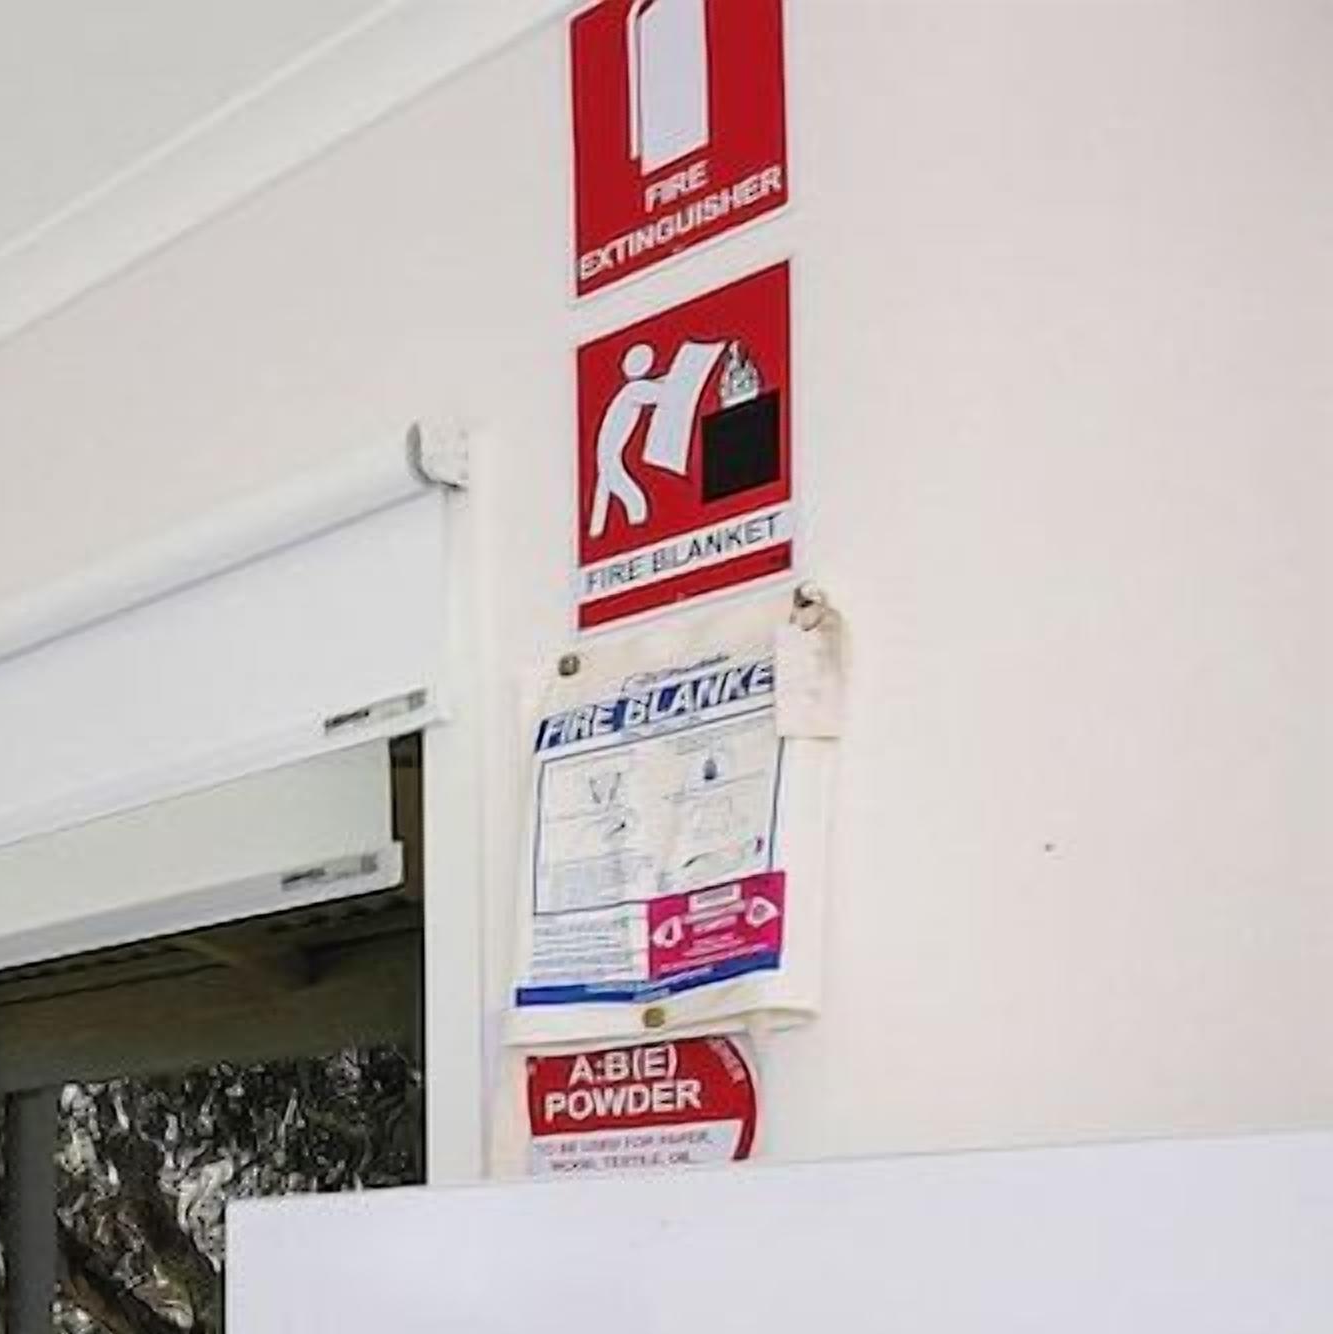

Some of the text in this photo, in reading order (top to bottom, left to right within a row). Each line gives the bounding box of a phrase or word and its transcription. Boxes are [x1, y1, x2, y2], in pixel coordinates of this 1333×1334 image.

[580, 165, 782, 280] EXTINGUISHER
[645, 160, 709, 213] FIRE
[587, 514, 780, 594] FIRE BLANKET
[539, 704, 617, 748] FIRE
[622, 664, 773, 726] BLANKE
[544, 1079, 703, 1122] POWDER
